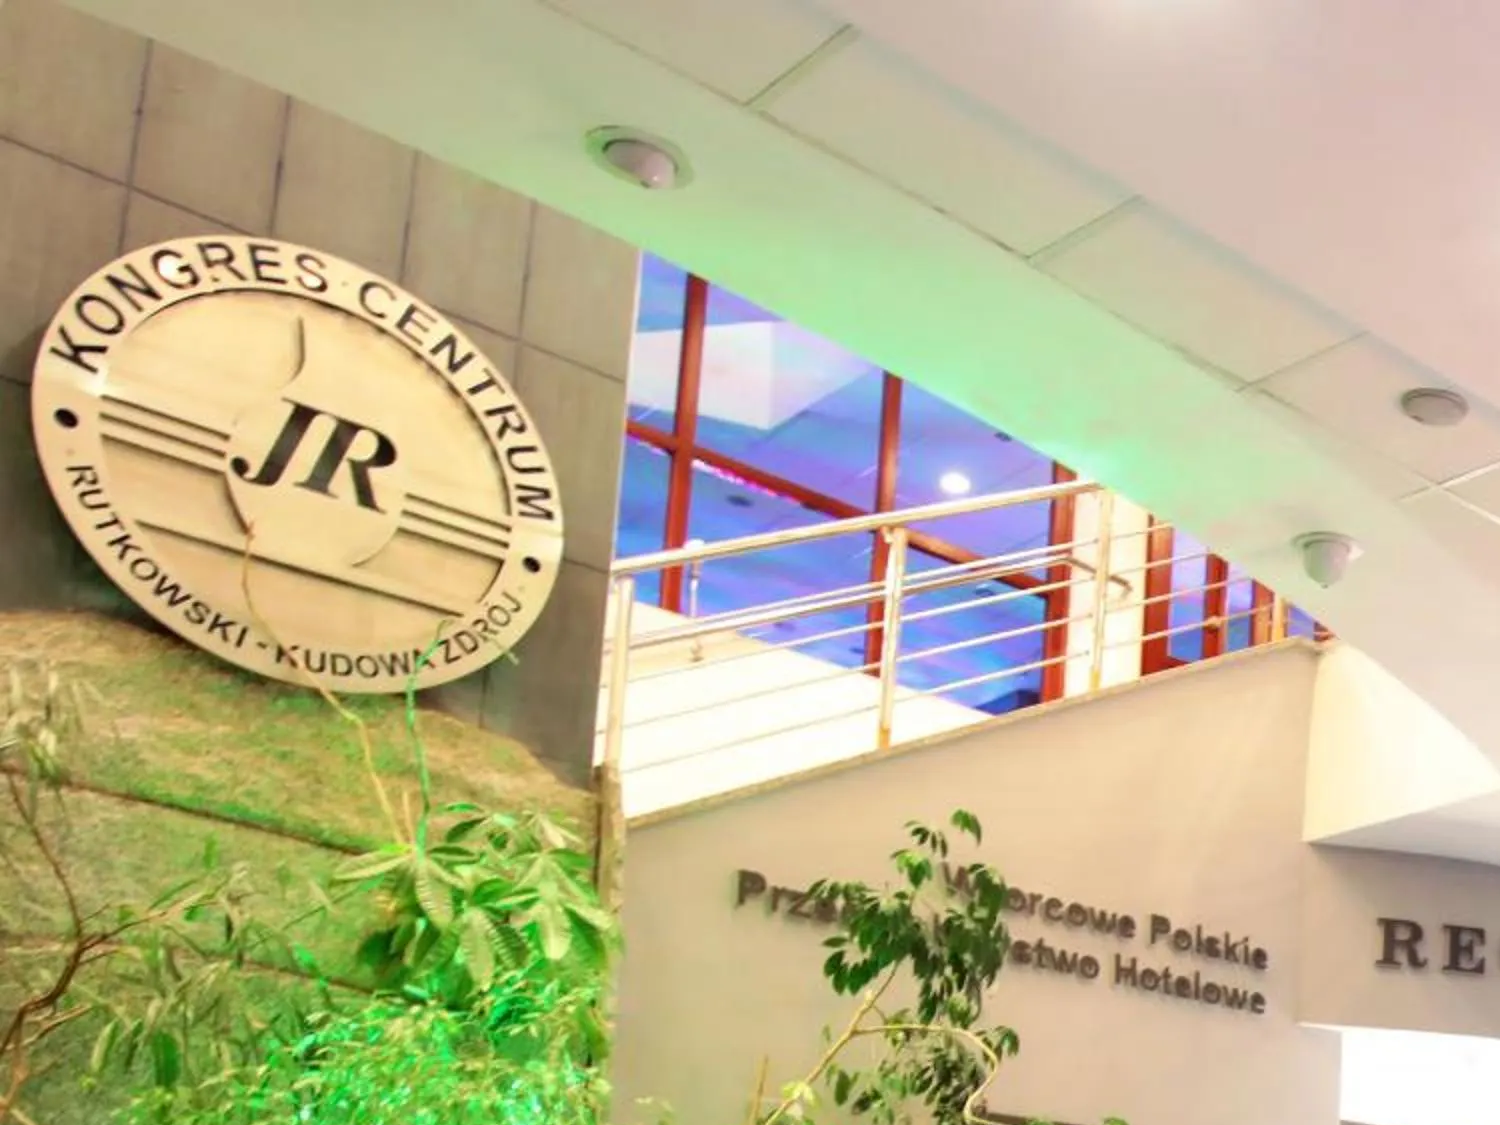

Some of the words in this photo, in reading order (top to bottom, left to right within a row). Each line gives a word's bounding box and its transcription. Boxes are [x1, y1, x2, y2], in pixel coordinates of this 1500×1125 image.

[50, 241, 329, 374] KONGRES
[358, 280, 555, 522] CENTRUM
[229, 396, 398, 515] JR
[66, 465, 249, 649] RUTKOWSKI
[1113, 952, 1267, 1014] Hotelowe
[1149, 913, 1270, 970] Polskie
